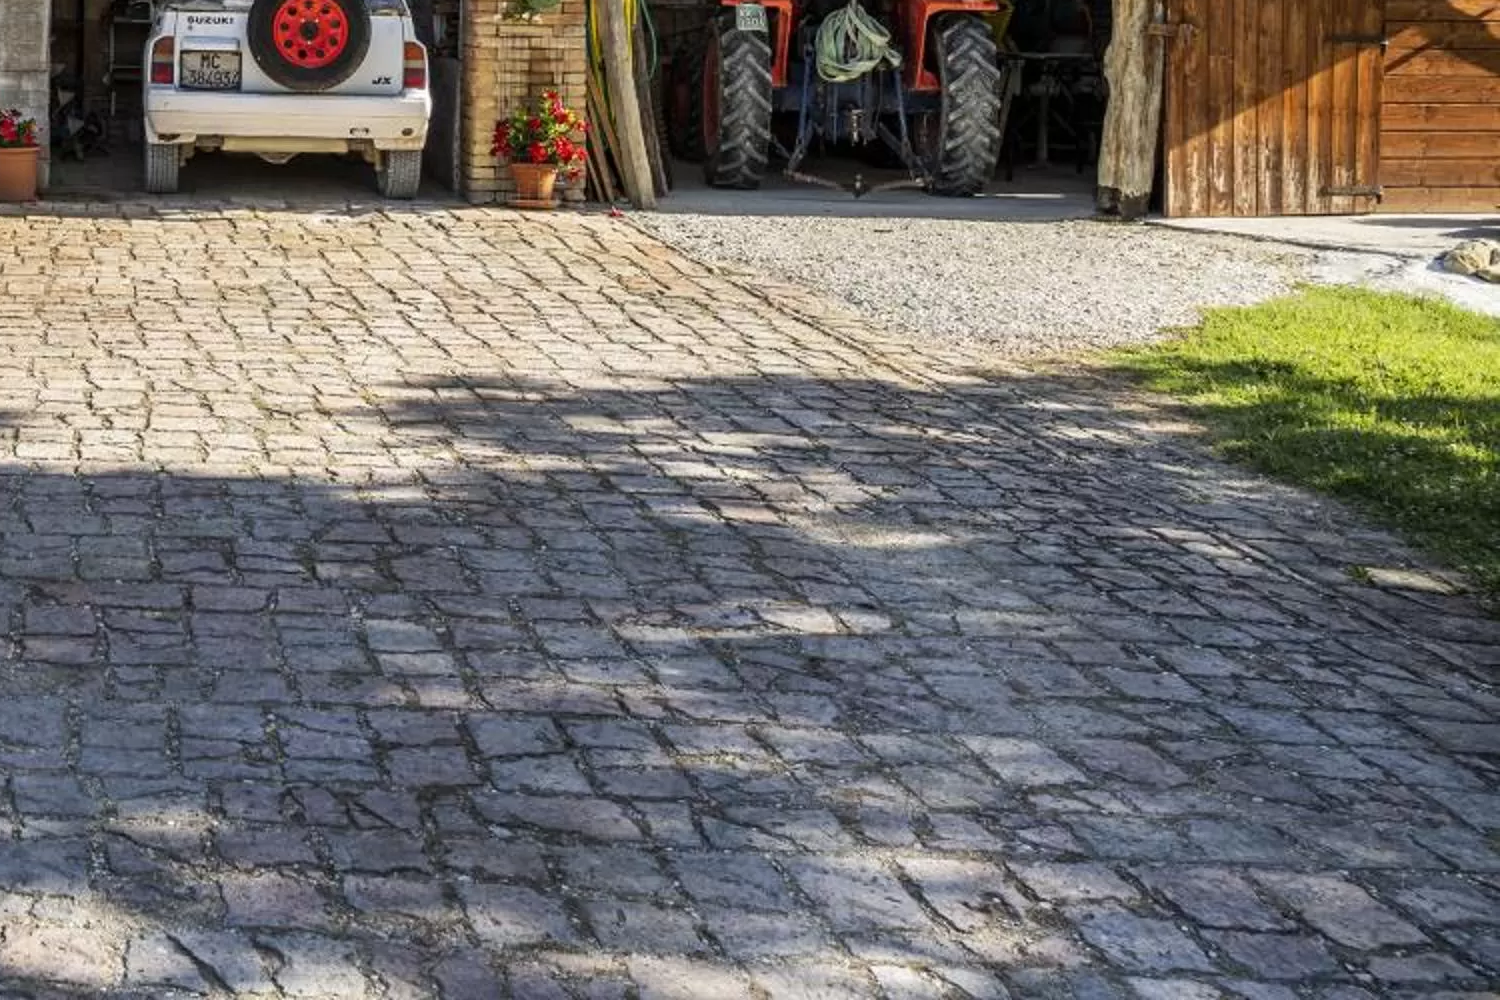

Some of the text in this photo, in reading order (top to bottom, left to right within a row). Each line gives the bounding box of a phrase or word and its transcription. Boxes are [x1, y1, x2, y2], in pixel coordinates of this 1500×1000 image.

[187, 15, 235, 25] SUZUKI
[200, 52, 221, 69] MC
[371, 75, 392, 85] JX
